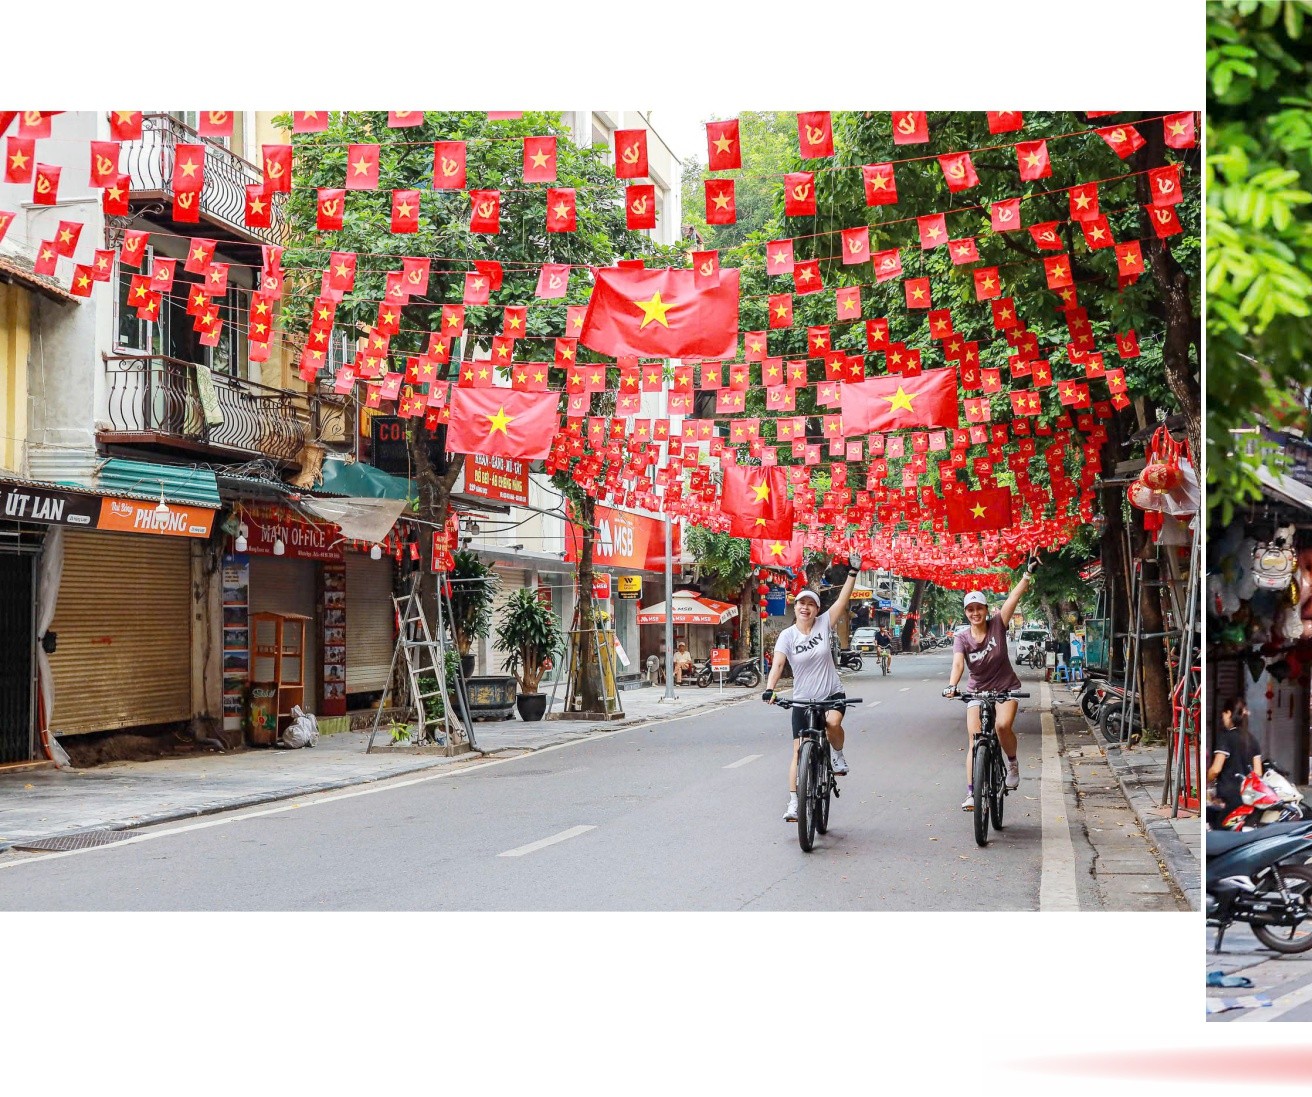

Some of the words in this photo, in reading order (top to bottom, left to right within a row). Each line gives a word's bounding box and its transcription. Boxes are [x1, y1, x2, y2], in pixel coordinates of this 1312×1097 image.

[5, 488, 30, 517] ÚT
[31, 496, 65, 521] LAN
[614, 524, 634, 558] MSB
[712, 650, 719, 658] P
[795, 633, 824, 654] DKNY
